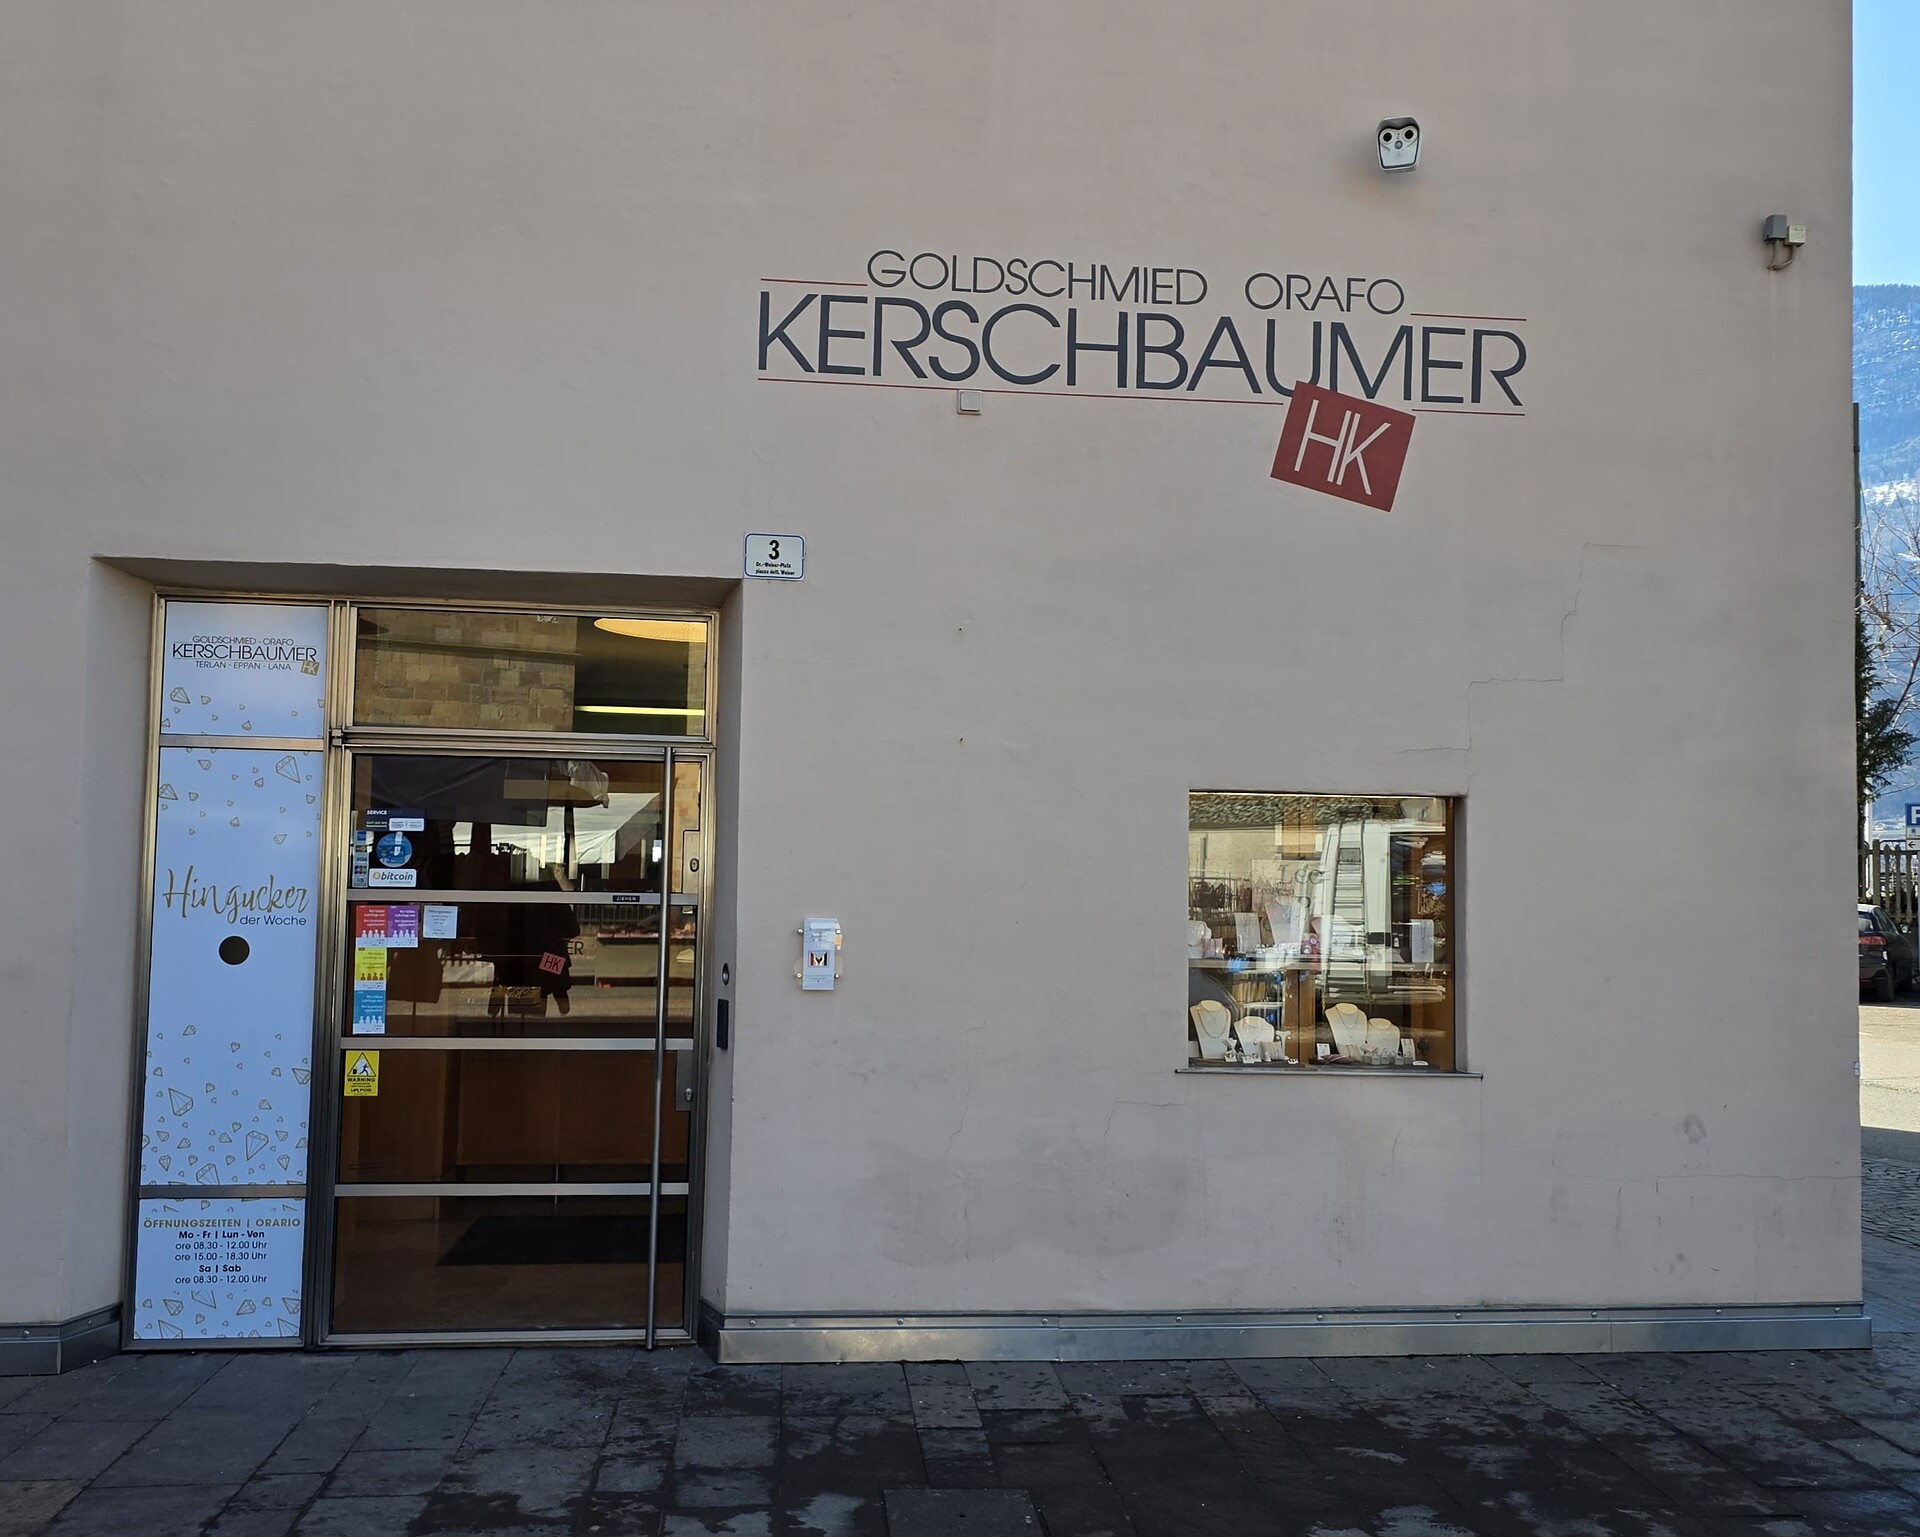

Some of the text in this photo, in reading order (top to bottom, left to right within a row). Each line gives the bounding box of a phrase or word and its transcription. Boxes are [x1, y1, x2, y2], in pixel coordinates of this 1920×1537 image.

[867, 249, 1405, 315] GOLDSCHMIED ORAFO
[758, 290, 1528, 406] KERSCHBAUMER
[1293, 399, 1392, 496] HK
[768, 539, 780, 560] 3
[192, 635, 257, 645] GOLDSCHMIED
[262, 637, 294, 646] ORAFO
[172, 643, 317, 662] KERSCHBAUMER
[195, 660, 227, 669] TERLAN
[233, 662, 261, 670] EPPAN
[267, 663, 292, 671] LANA
[380, 871, 413, 881] bitcoin
[162, 865, 310, 925] Hingucker
[239, 915, 307, 926] der Woche
[543, 954, 562, 972] HK
[143, 1217, 241, 1228] ÖFFNUNGSZEITEN
[255, 1217, 301, 1228] ORARIO
[178, 1230, 194, 1239] Mo
[202, 1230, 211, 1239] Fr
[222, 1230, 239, 1239] Lun
[246, 1230, 265, 1238] Ven
[175, 1242, 191, 1250] ore
[193, 1241, 218, 1250] 08.30
[226, 1241, 249, 1249] 12.00
[251, 1241, 267, 1249] Uhr
[174, 1253, 191, 1261] ore
[194, 1252, 218, 1260] 15.00
[226, 1252, 249, 1260] 18.30
[251, 1252, 267, 1260] Uhr
[222, 1264, 241, 1272] Sab
[175, 1276, 191, 1284] ore
[193, 1275, 217, 1284] 08.30
[226, 1275, 249, 1283] 12.00
[251, 1275, 267, 1283] Uhr
